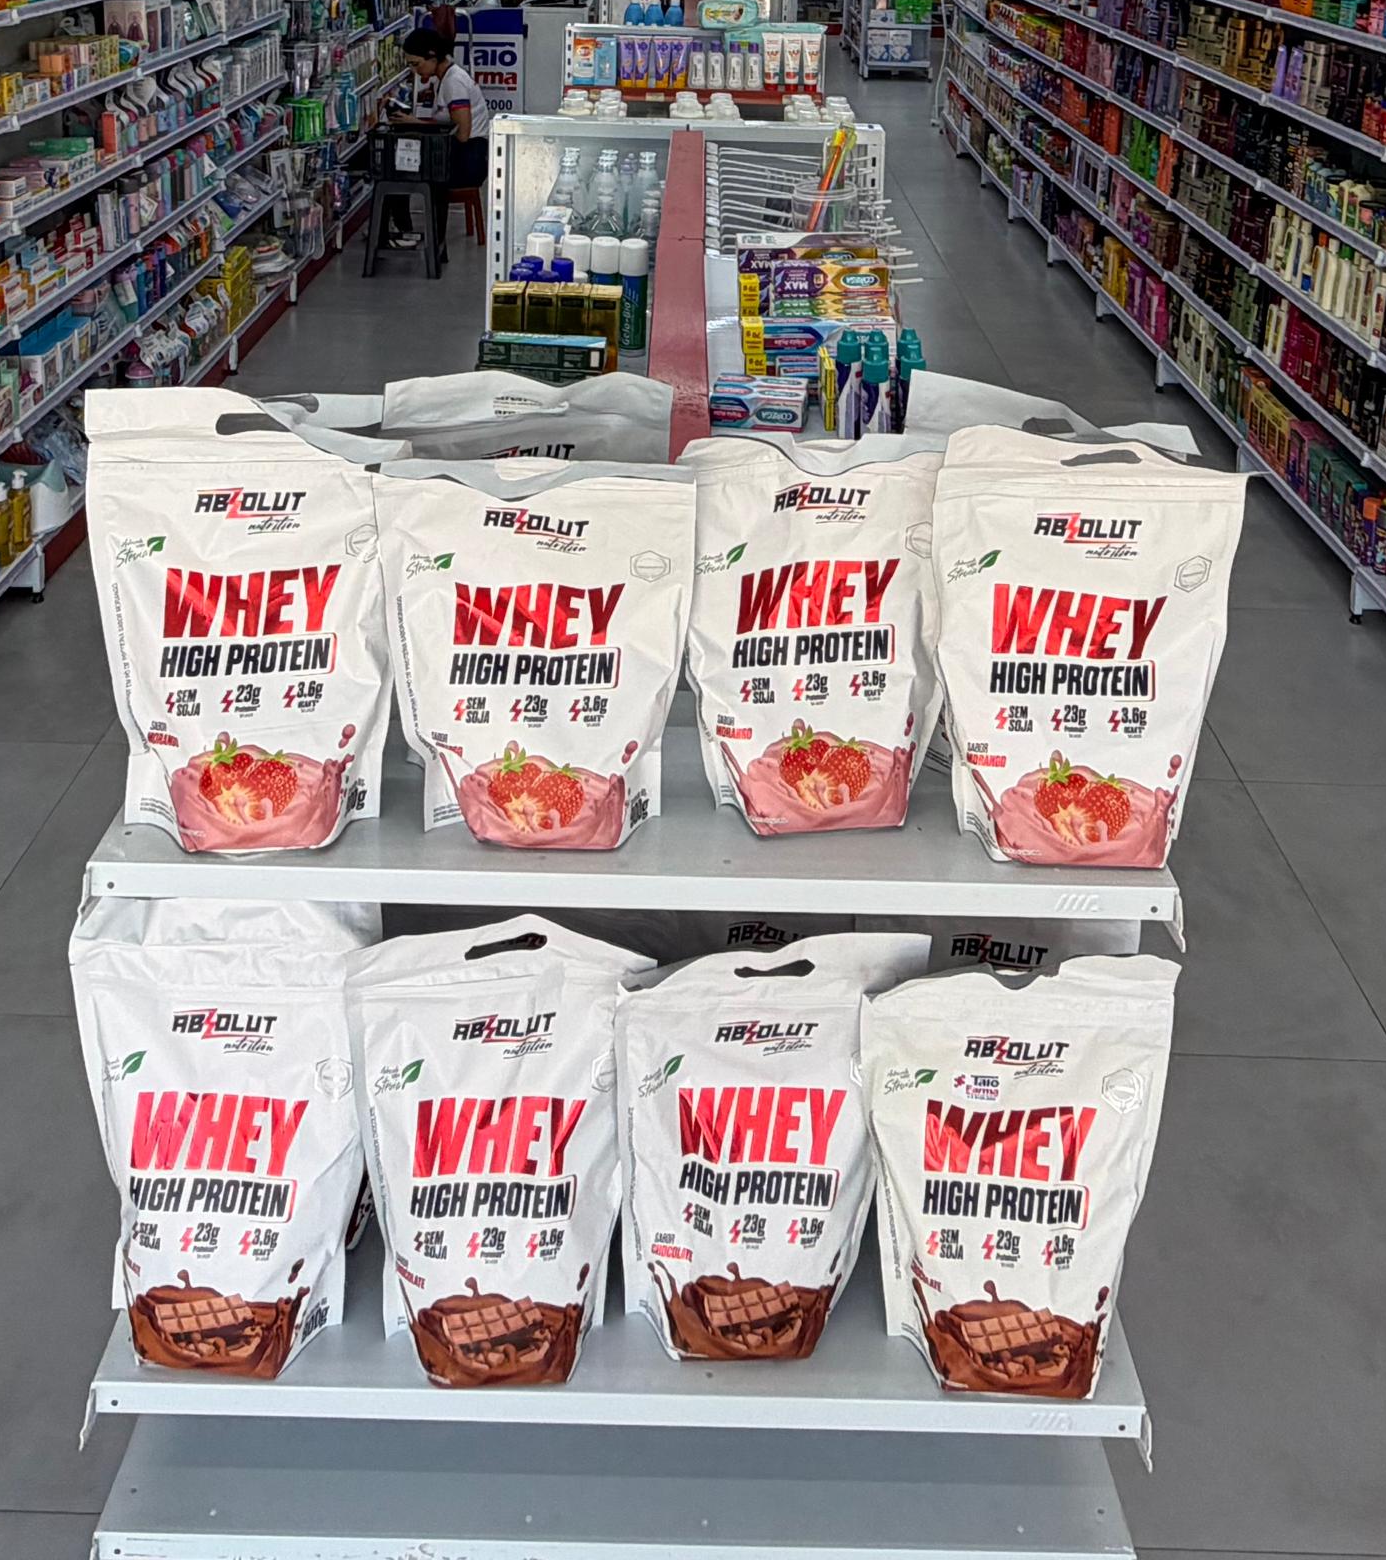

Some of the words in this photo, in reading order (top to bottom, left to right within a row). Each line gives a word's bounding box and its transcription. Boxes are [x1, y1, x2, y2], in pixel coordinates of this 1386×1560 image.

[784, 279, 809, 290] MAX
[162, 564, 342, 639] WHEY
[736, 558, 901, 636] WHEY
[453, 581, 626, 649] WHEY
[991, 582, 1168, 662] WHEY
[160, 643, 226, 679] HIGH
[226, 637, 330, 676] PROTEIN
[732, 635, 790, 669] HIGH
[794, 629, 889, 667] PROTEIN
[449, 653, 515, 687] HIGH
[514, 650, 614, 687] PROTEIN
[989, 660, 1048, 696] HIGH
[1051, 662, 1149, 698] PROTEIN
[176, 689, 197, 703] SEM
[234, 683, 262, 705] 23g
[751, 677, 771, 691] SEM
[752, 689, 775, 704] SOJA
[805, 673, 829, 696] 23g
[176, 703, 201, 717] SOJA
[465, 696, 487, 710] SEM
[465, 709, 490, 724] SOJA
[523, 694, 549, 717] 23g
[1008, 706, 1029, 719] SEM
[1063, 705, 1087, 727] 23g
[1008, 718, 1034, 733] SOJA
[130, 1091, 309, 1177] WHEY
[411, 1097, 587, 1179] WHEY
[678, 1087, 847, 1166] WHEY
[924, 1100, 1097, 1182] WHEY
[129, 1175, 187, 1213] HIGH
[187, 1179, 289, 1218] PROTEIN
[679, 1162, 728, 1205] HIGH
[734, 1168, 833, 1208] PROTEIN
[410, 1182, 471, 1220] HIGH
[474, 1180, 571, 1221] PROTEIN
[194, 1222, 221, 1245] 23g
[481, 1227, 506, 1250] 23g
